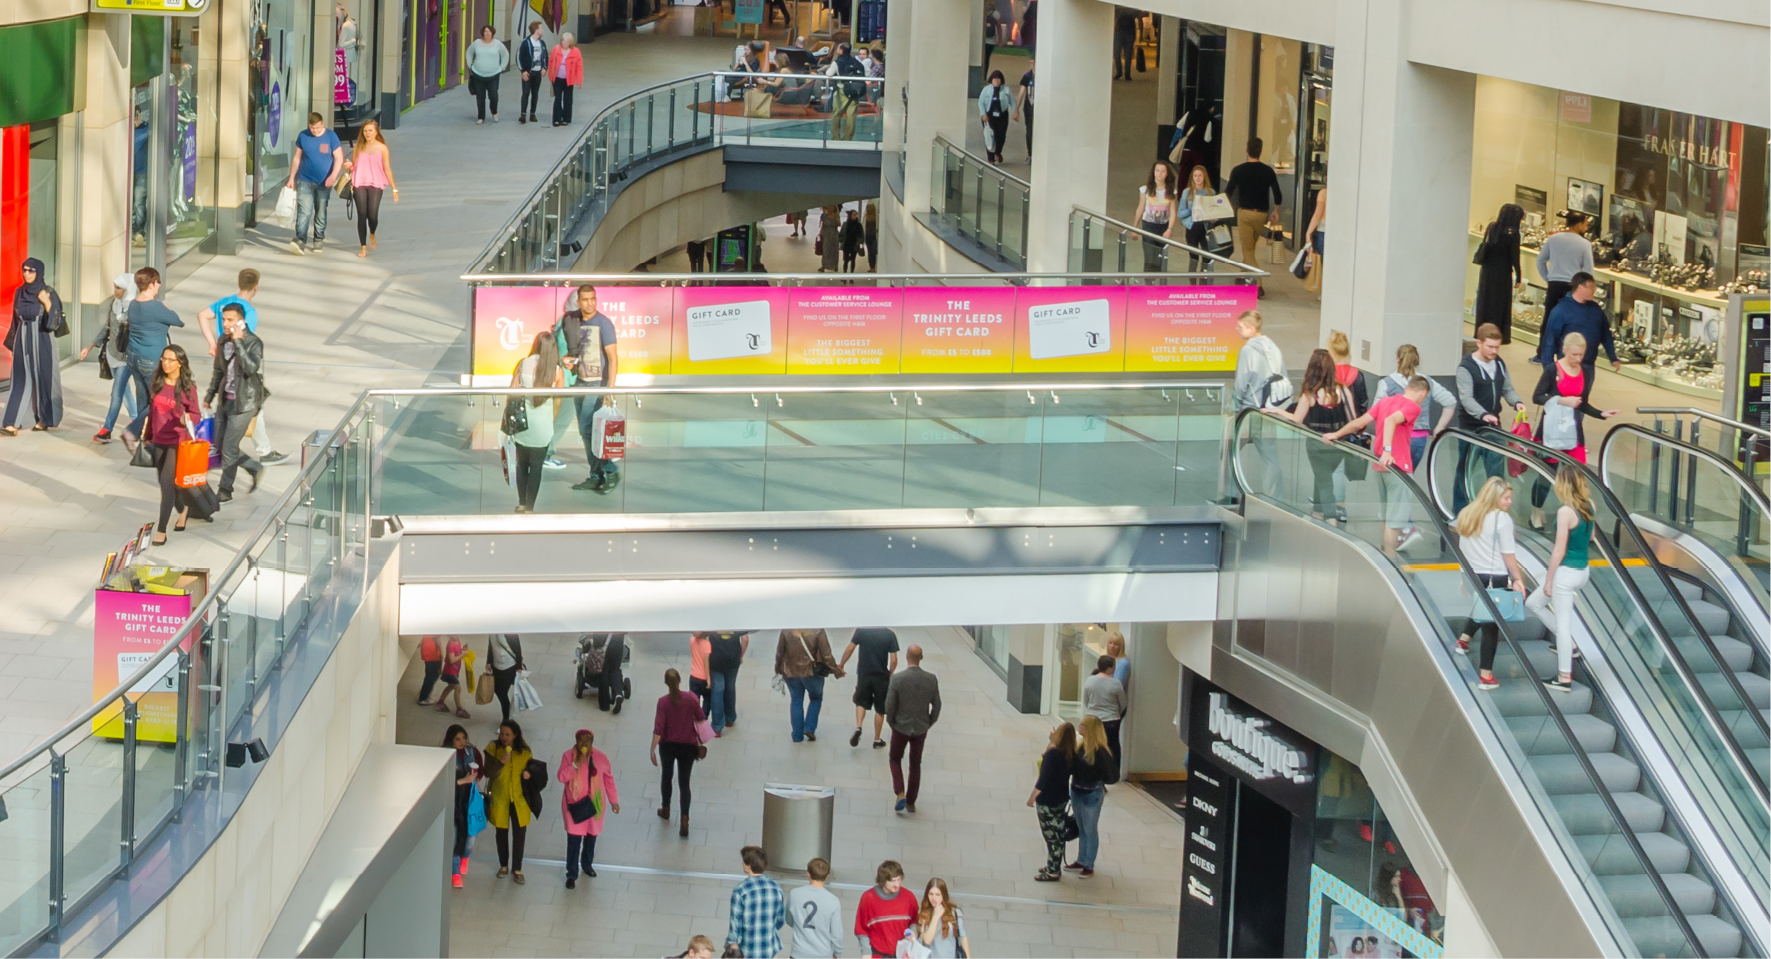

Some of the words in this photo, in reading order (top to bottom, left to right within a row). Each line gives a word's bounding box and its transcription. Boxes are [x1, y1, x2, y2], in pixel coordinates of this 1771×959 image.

[1644, 134, 1695, 163] FRASER
[1699, 145, 1737, 170] HART
[602, 302, 626, 312] THE
[947, 301, 970, 310] THE
[691, 311, 713, 320] GIFT
[715, 308, 741, 318] CARD
[1033, 310, 1054, 318] GIFT
[1056, 307, 1081, 316] CARD
[622, 315, 660, 325] LEEDS
[913, 314, 962, 324] TRINITY
[966, 314, 1003, 324] LEEDS
[925, 327, 953, 337] GIFT
[956, 327, 990, 337] CARD
[816, 339, 833, 347] THE
[835, 339, 871, 347] BIGGEST
[629, 350, 649, 358] £500
[1151, 346, 1177, 354] LITTLE
[1179, 346, 1228, 354] SOMETHING
[1152, 354, 1181, 362] YOU'LL
[1183, 354, 1205, 362] EVER
[1206, 354, 1226, 362] GIVE
[142, 604, 161, 613] THE
[115, 612, 153, 623] TRINITY
[156, 615, 187, 625] LEEDS
[124, 623, 147, 633] GIFT
[149, 625, 177, 635] CARD
[122, 636, 142, 644] FROM
[143, 703, 171, 711] BIGGEST
[1192, 796, 1218, 817] DKNY
[1189, 852, 1216, 875] GUESS
[802, 900, 818, 930] 2
